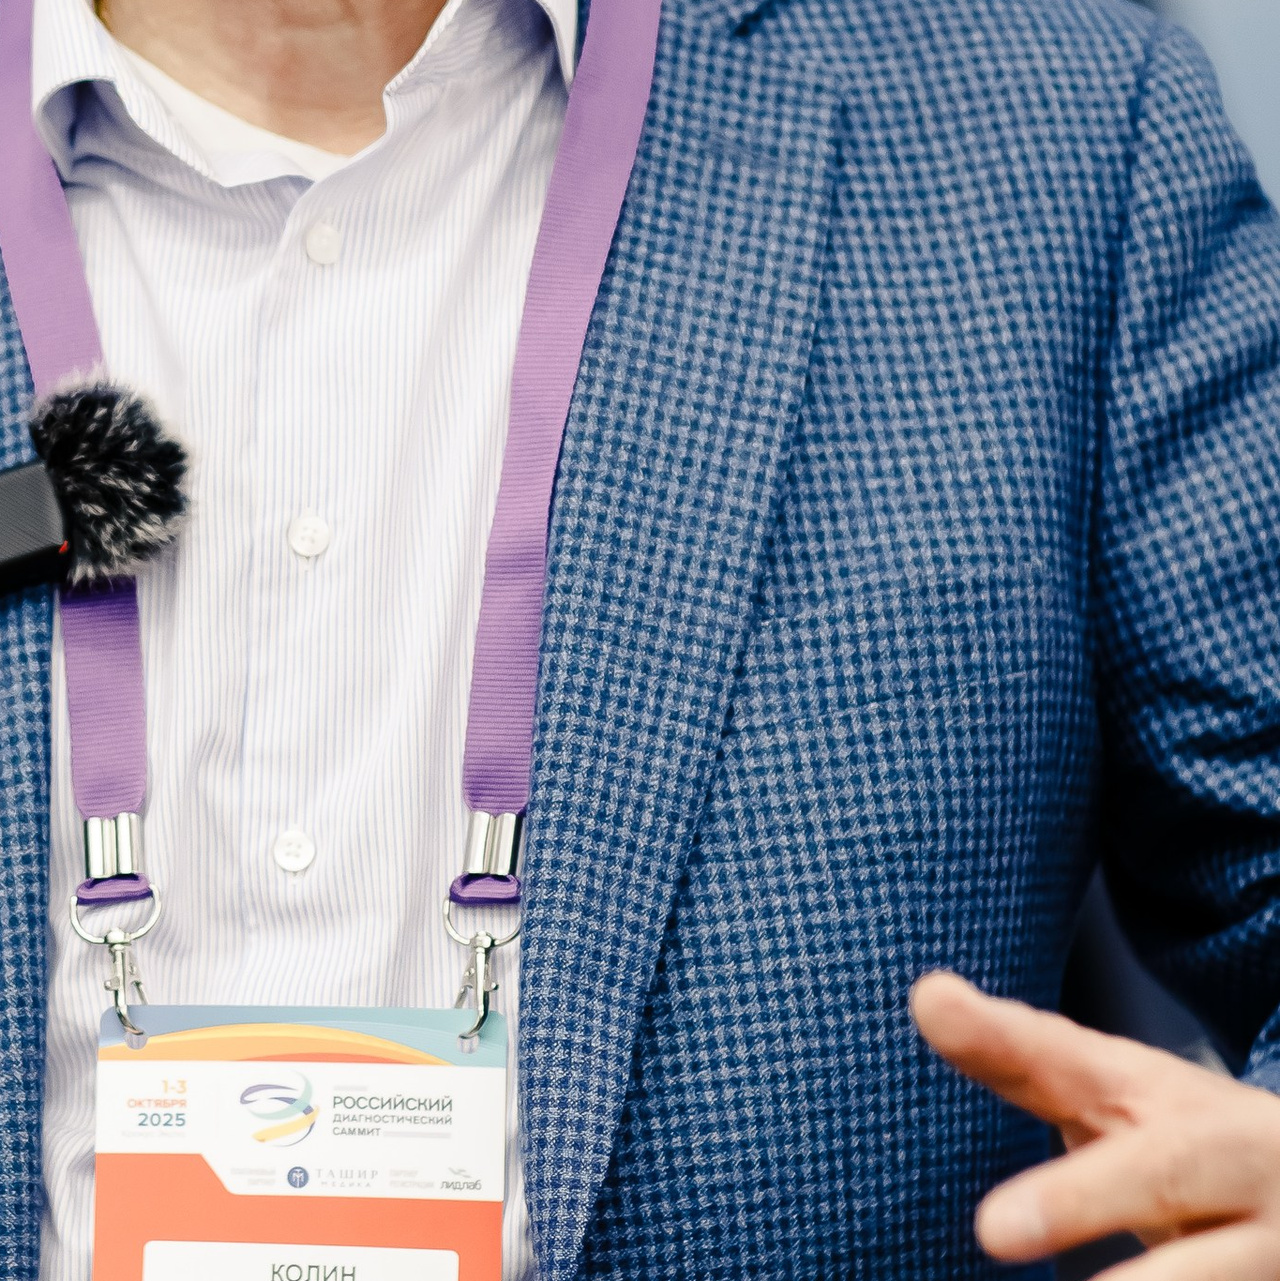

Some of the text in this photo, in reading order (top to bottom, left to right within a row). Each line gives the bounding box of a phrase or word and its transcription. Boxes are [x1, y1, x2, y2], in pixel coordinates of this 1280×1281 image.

[162, 1079, 188, 1094] 1-3
[127, 1098, 187, 1109] ОКТЯБРЯ
[332, 1094, 453, 1112] РОССИЙСКИЙ
[138, 1112, 186, 1127] 2025
[332, 1113, 453, 1125] ДИАГНОСТИЧЕСКИЙ
[332, 1126, 381, 1137] САММИТ
[315, 1168, 379, 1181] ТАШИР
[440, 1179, 483, 1191] лидлаб
